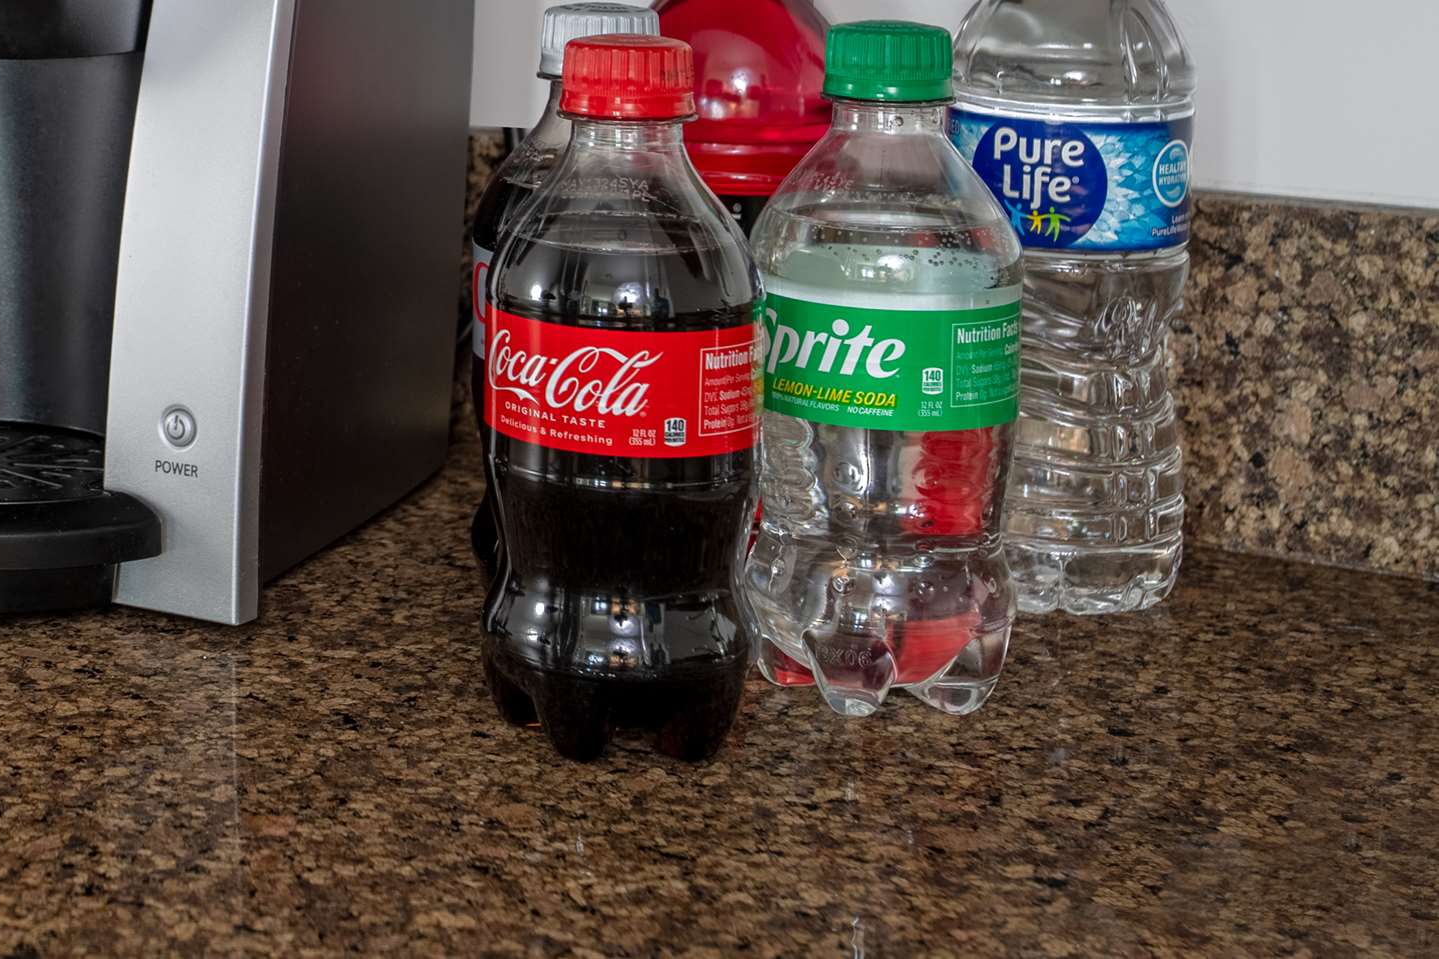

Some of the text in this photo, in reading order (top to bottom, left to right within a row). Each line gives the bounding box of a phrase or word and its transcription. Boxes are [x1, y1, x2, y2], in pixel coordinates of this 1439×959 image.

[993, 127, 1086, 167] Pure
[1003, 164, 1071, 210] Life
[956, 326, 1002, 344] Nutrition
[705, 349, 748, 370] Nutrition
[488, 329, 664, 417] Coca-Cola
[924, 370, 942, 381] 140
[772, 378, 852, 403] LEMON-LIME
[854, 391, 896, 407] SODA
[505, 401, 606, 429] ORIGINAL TASTE
[810, 401, 840, 412] FLAVORS
[848, 406, 859, 414] NO
[859, 406, 895, 417] CAFFEINE
[500, 415, 613, 446] Delicious & Refreshing
[666, 419, 685, 431] 140
[155, 460, 198, 478] POWER
